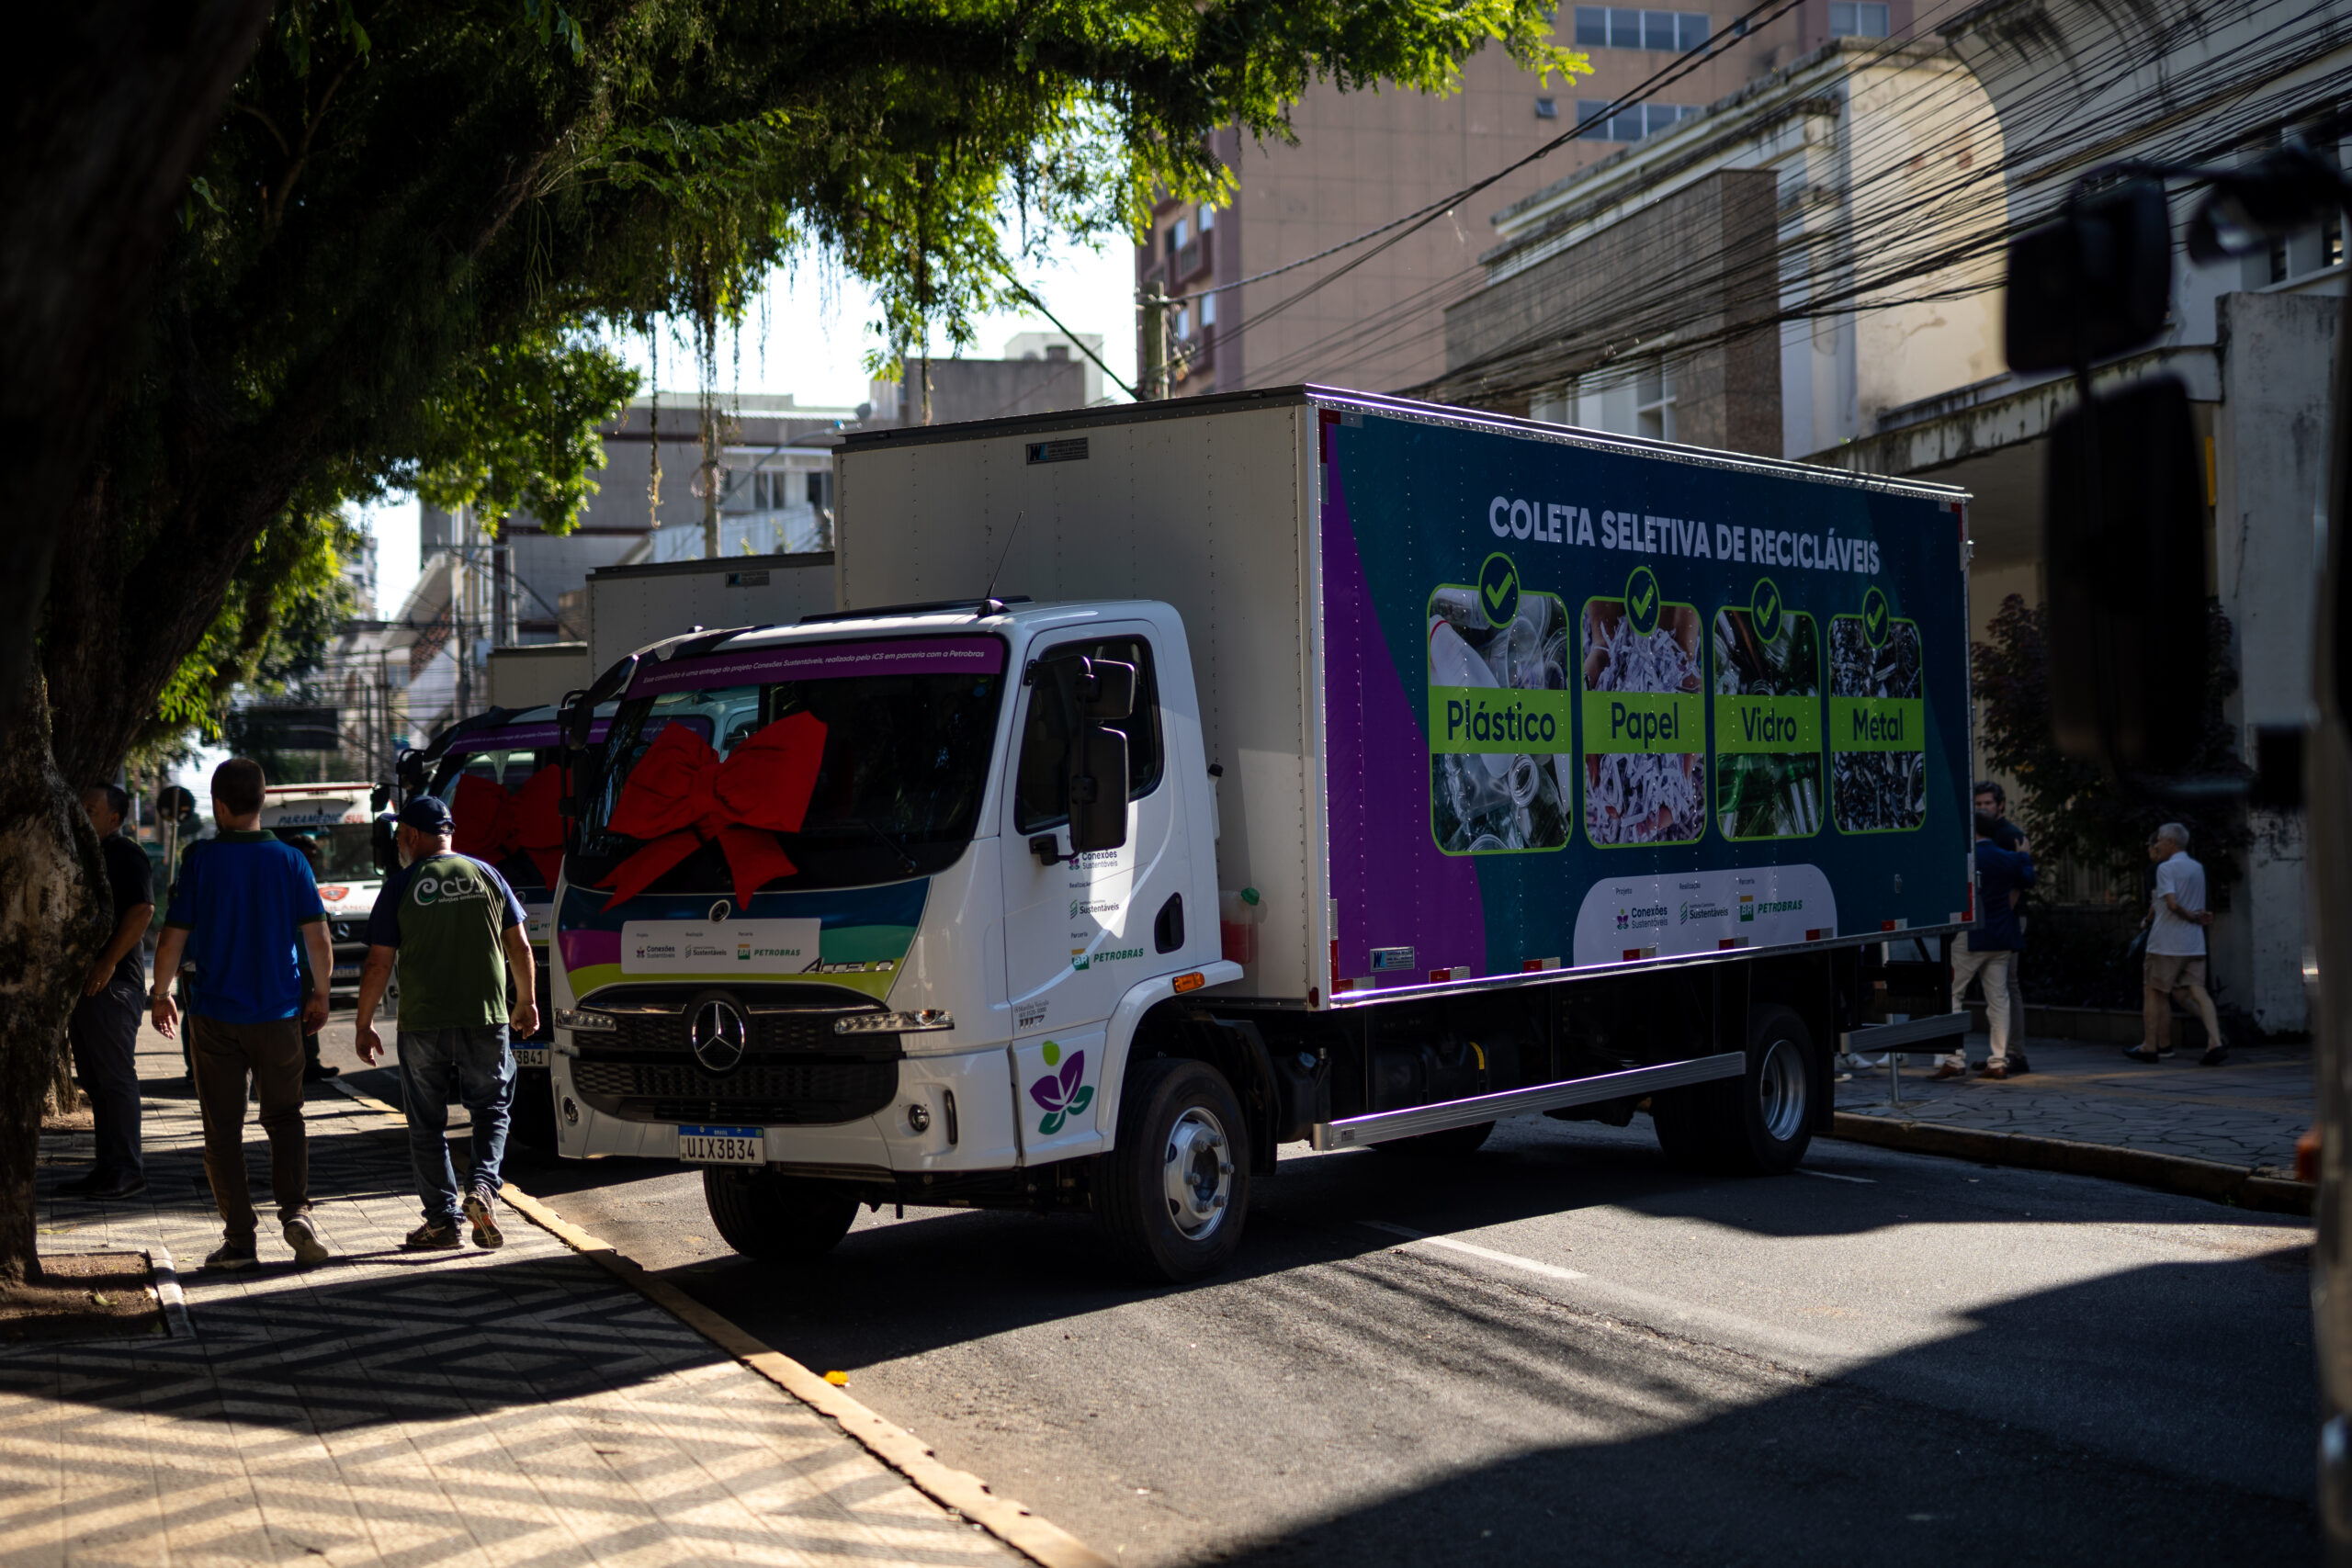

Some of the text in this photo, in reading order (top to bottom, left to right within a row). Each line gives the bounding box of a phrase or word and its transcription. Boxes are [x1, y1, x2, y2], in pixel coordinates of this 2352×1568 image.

[1488, 496, 1880, 575] COLETA SELETIVA DE RECICLÁVEIS
[698, 668, 722, 676] entrega
[730, 663, 752, 673] projeto
[753, 660, 783, 670] Conexões
[825, 654, 854, 663] realizado
[855, 653, 871, 662] pelo
[872, 652, 884, 660] ICS
[896, 650, 925, 660] parceria
[949, 649, 985, 658] Petrobras
[1447, 699, 1555, 742] Plástico
[1611, 702, 1679, 749] Papel
[1741, 706, 1797, 742] Vidro
[1853, 707, 1904, 741] Metal
[277, 813, 366, 825] PARAMEDIC SUL
[1081, 849, 1117, 861] Conexões
[1082, 859, 1118, 870] Sustentáveis
[1615, 887, 1633, 897] Projeto
[1080, 902, 1119, 915] Sustentáveis
[1631, 904, 1668, 918] Conexões
[1690, 907, 1728, 919] Sustentáveis
[1758, 899, 1804, 914] PETROBRAS
[1631, 917, 1668, 929] Sustentáveis
[646, 944, 675, 953] Conexões
[693, 948, 727, 956] Sustentáveis
[1073, 948, 1144, 965] BR PETROBRAS
[513, 1051, 543, 1065] 3B41
[687, 1138, 755, 1160] UIX3B34
